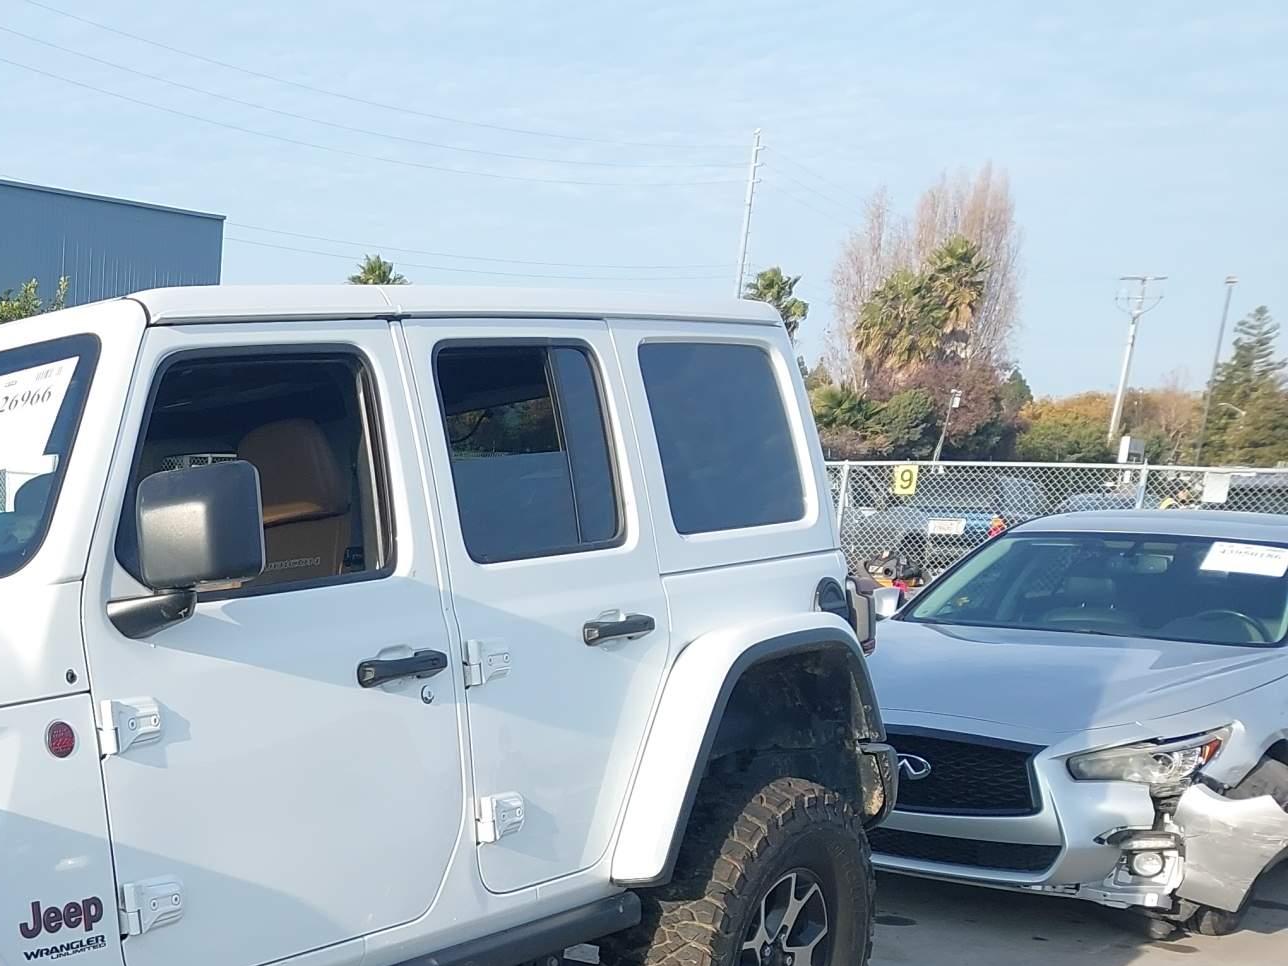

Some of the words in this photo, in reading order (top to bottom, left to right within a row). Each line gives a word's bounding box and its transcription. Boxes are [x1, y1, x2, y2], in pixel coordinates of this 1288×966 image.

[899, 468, 914, 489] 9
[19, 896, 104, 939] Jeep
[23, 934, 106, 961] WRANGLER
[50, 942, 107, 960] UNLIMITED
